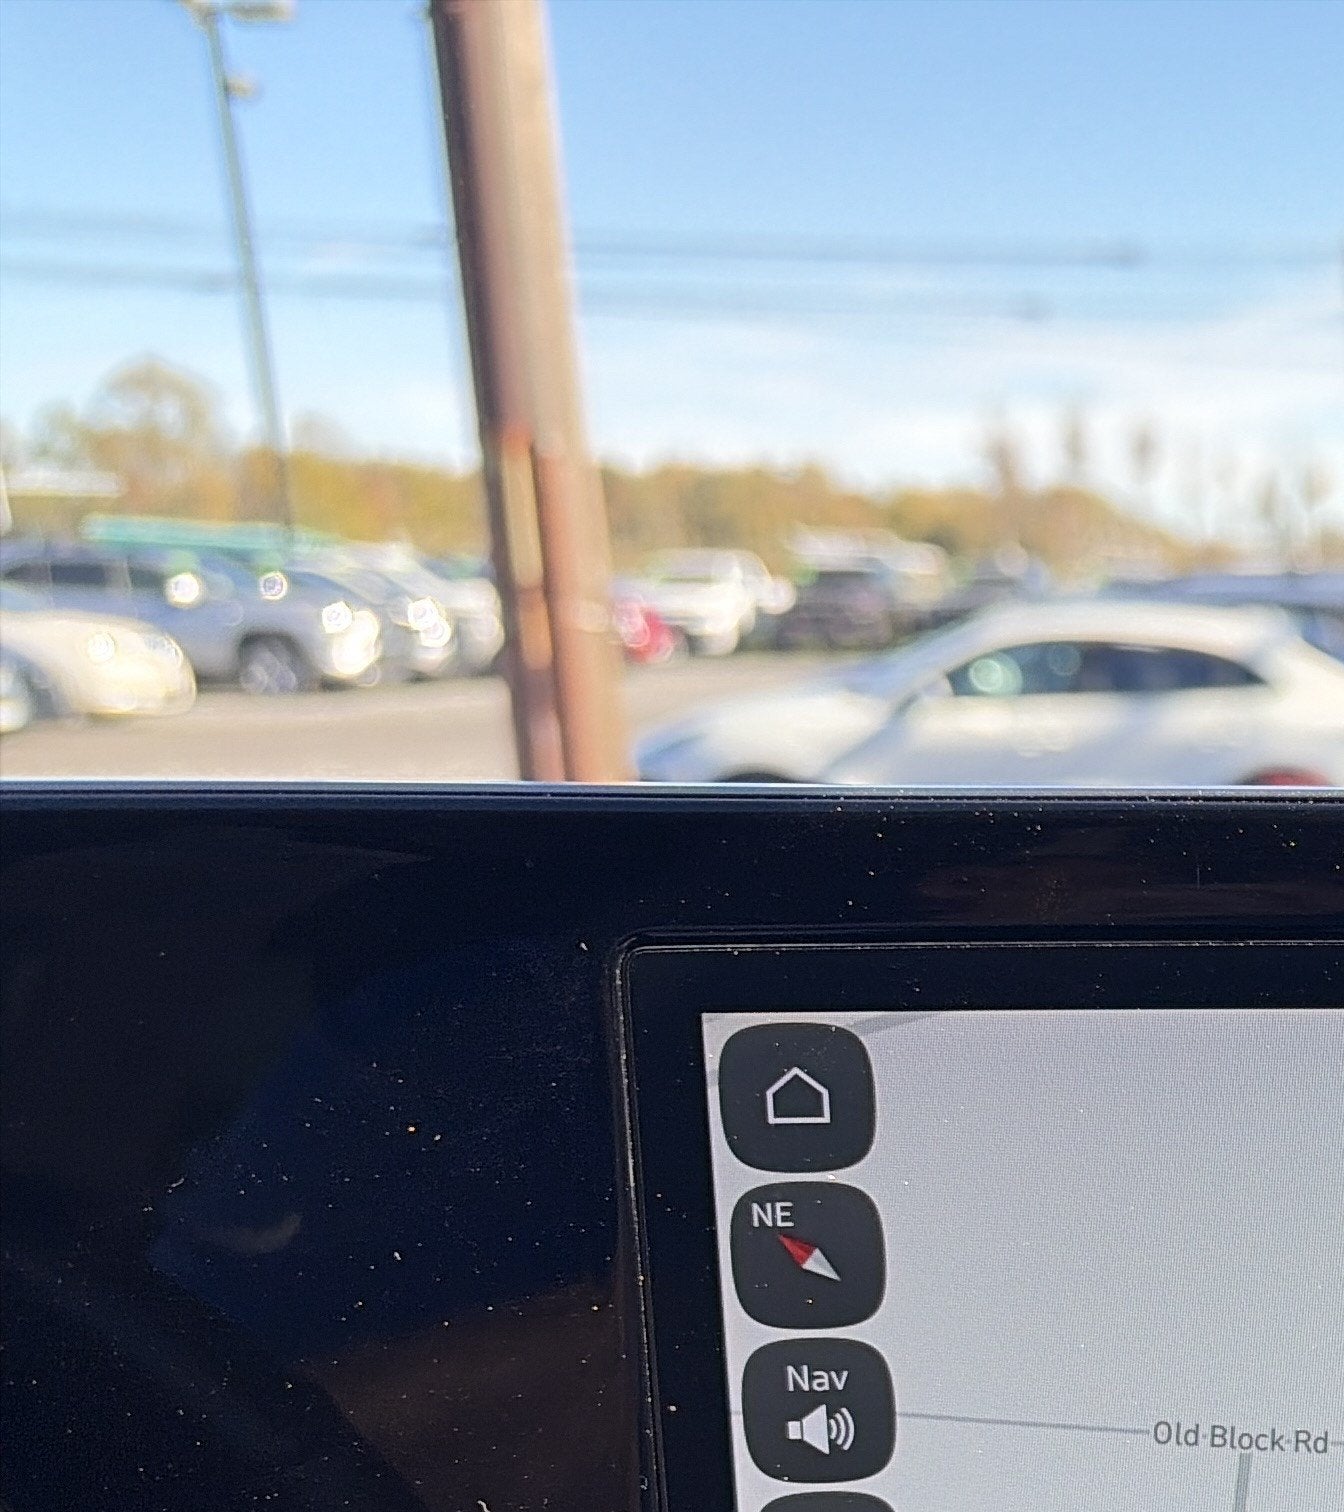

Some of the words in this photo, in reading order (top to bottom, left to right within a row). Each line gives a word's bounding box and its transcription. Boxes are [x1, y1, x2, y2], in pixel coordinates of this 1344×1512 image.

[751, 1202, 795, 1229] NE
[785, 1364, 849, 1392] Nav
[1152, 1420, 1200, 1448] Old
[1209, 1424, 1286, 1452] Block
[1294, 1430, 1329, 1455] Rd
